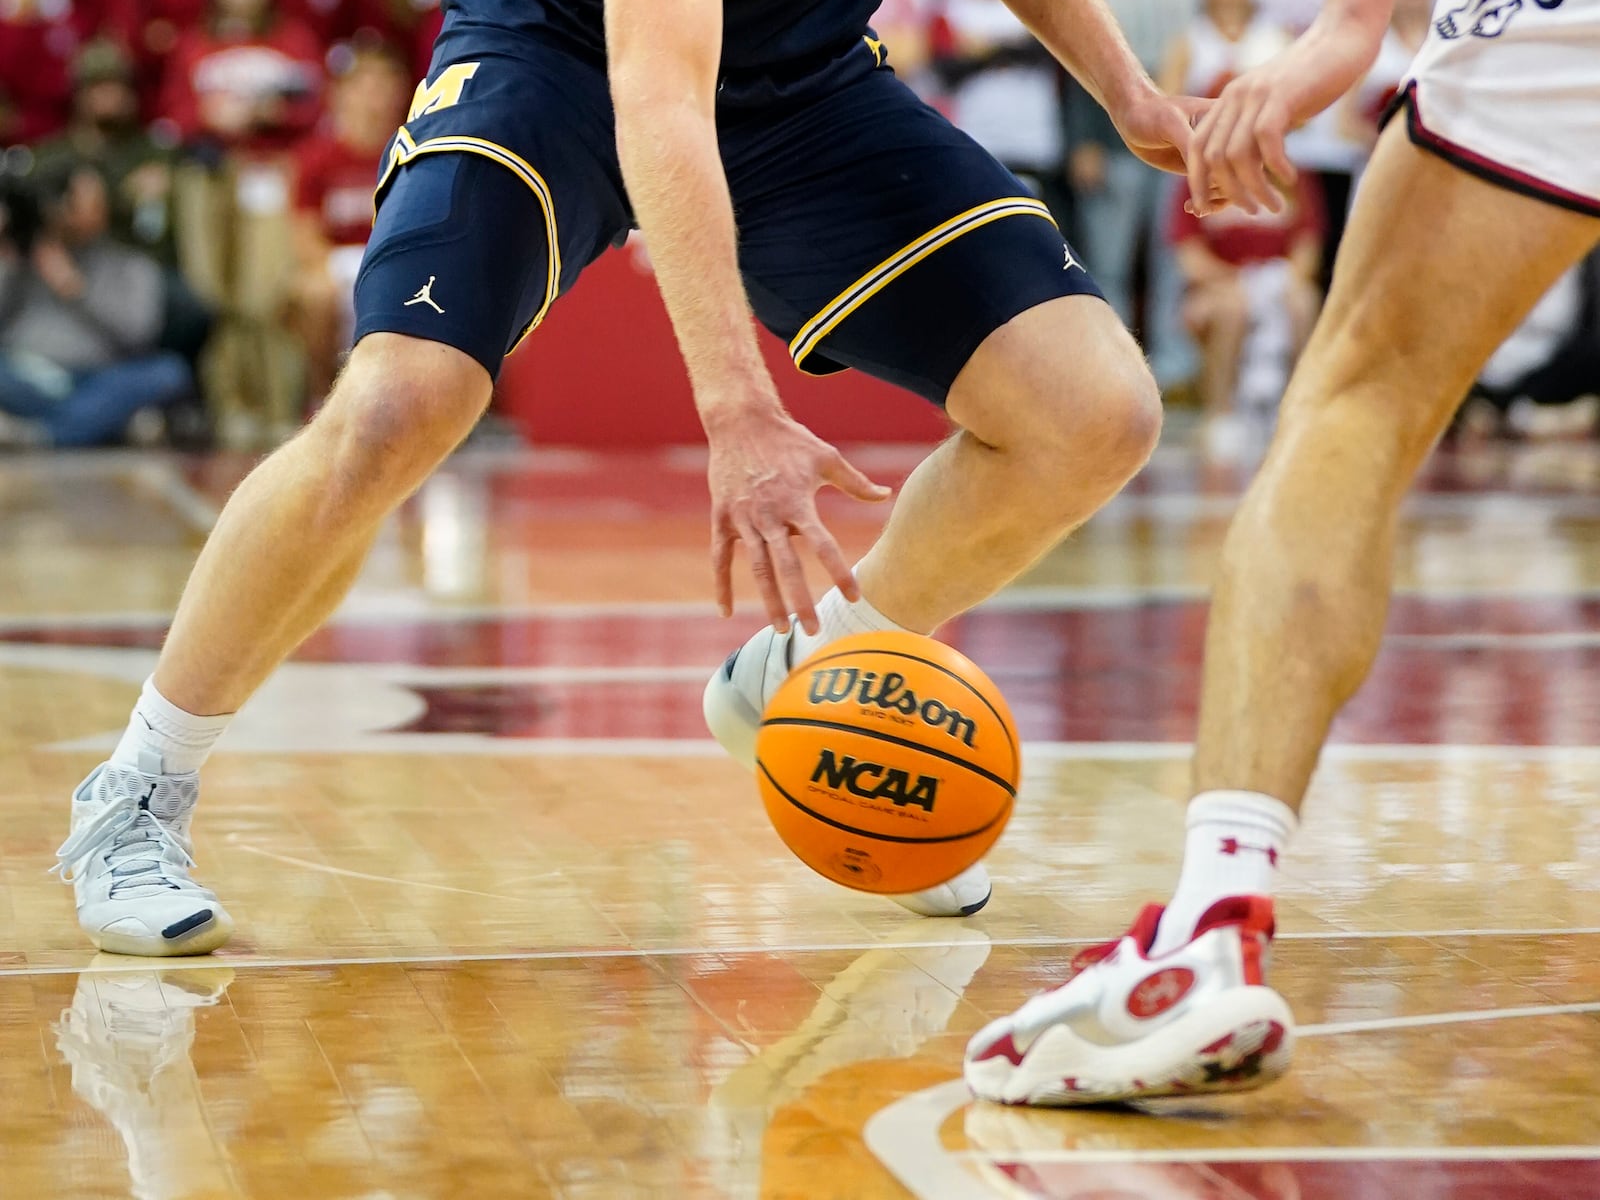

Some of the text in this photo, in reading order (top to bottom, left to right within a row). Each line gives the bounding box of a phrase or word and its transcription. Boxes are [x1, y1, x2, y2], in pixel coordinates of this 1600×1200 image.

[406, 62, 481, 124] M
[807, 667, 977, 751] Wilson
[810, 747, 938, 813] NCAA
